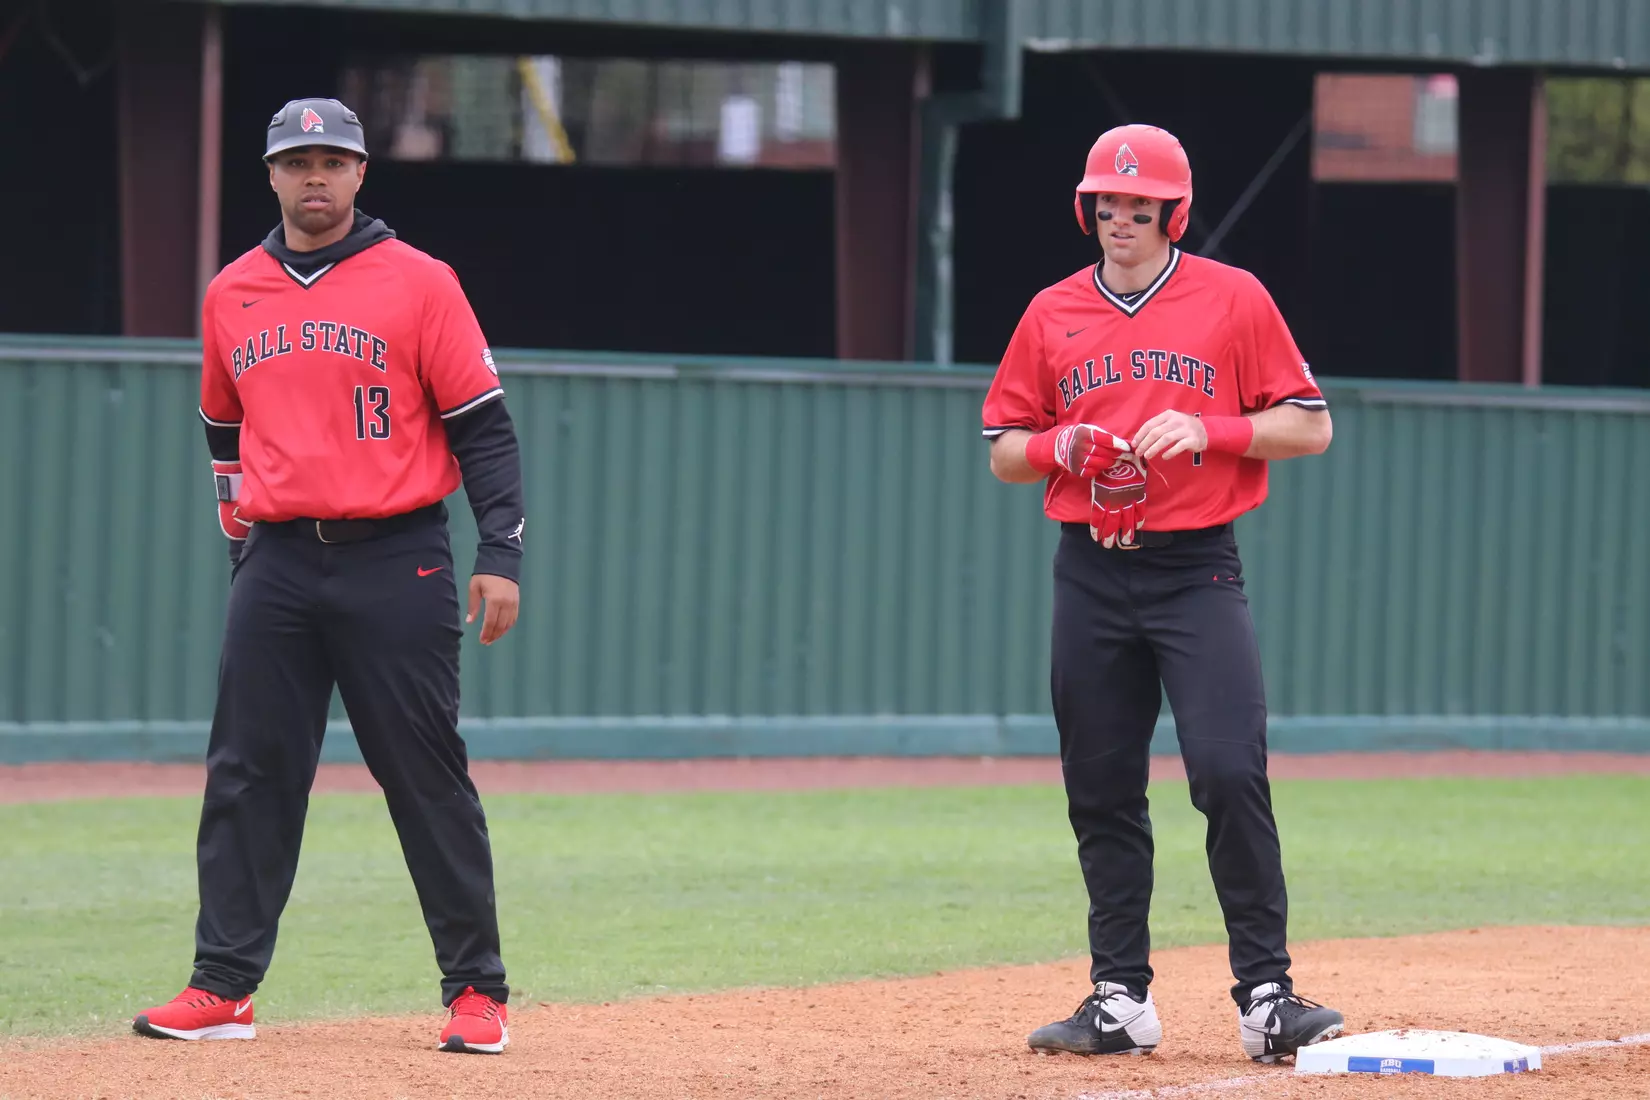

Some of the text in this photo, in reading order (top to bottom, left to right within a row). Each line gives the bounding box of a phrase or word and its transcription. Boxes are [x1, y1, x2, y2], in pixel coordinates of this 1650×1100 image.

[232, 321, 387, 381] BALL STATE
[1058, 350, 1215, 411] BALL STATE
[354, 386, 390, 440] 13
